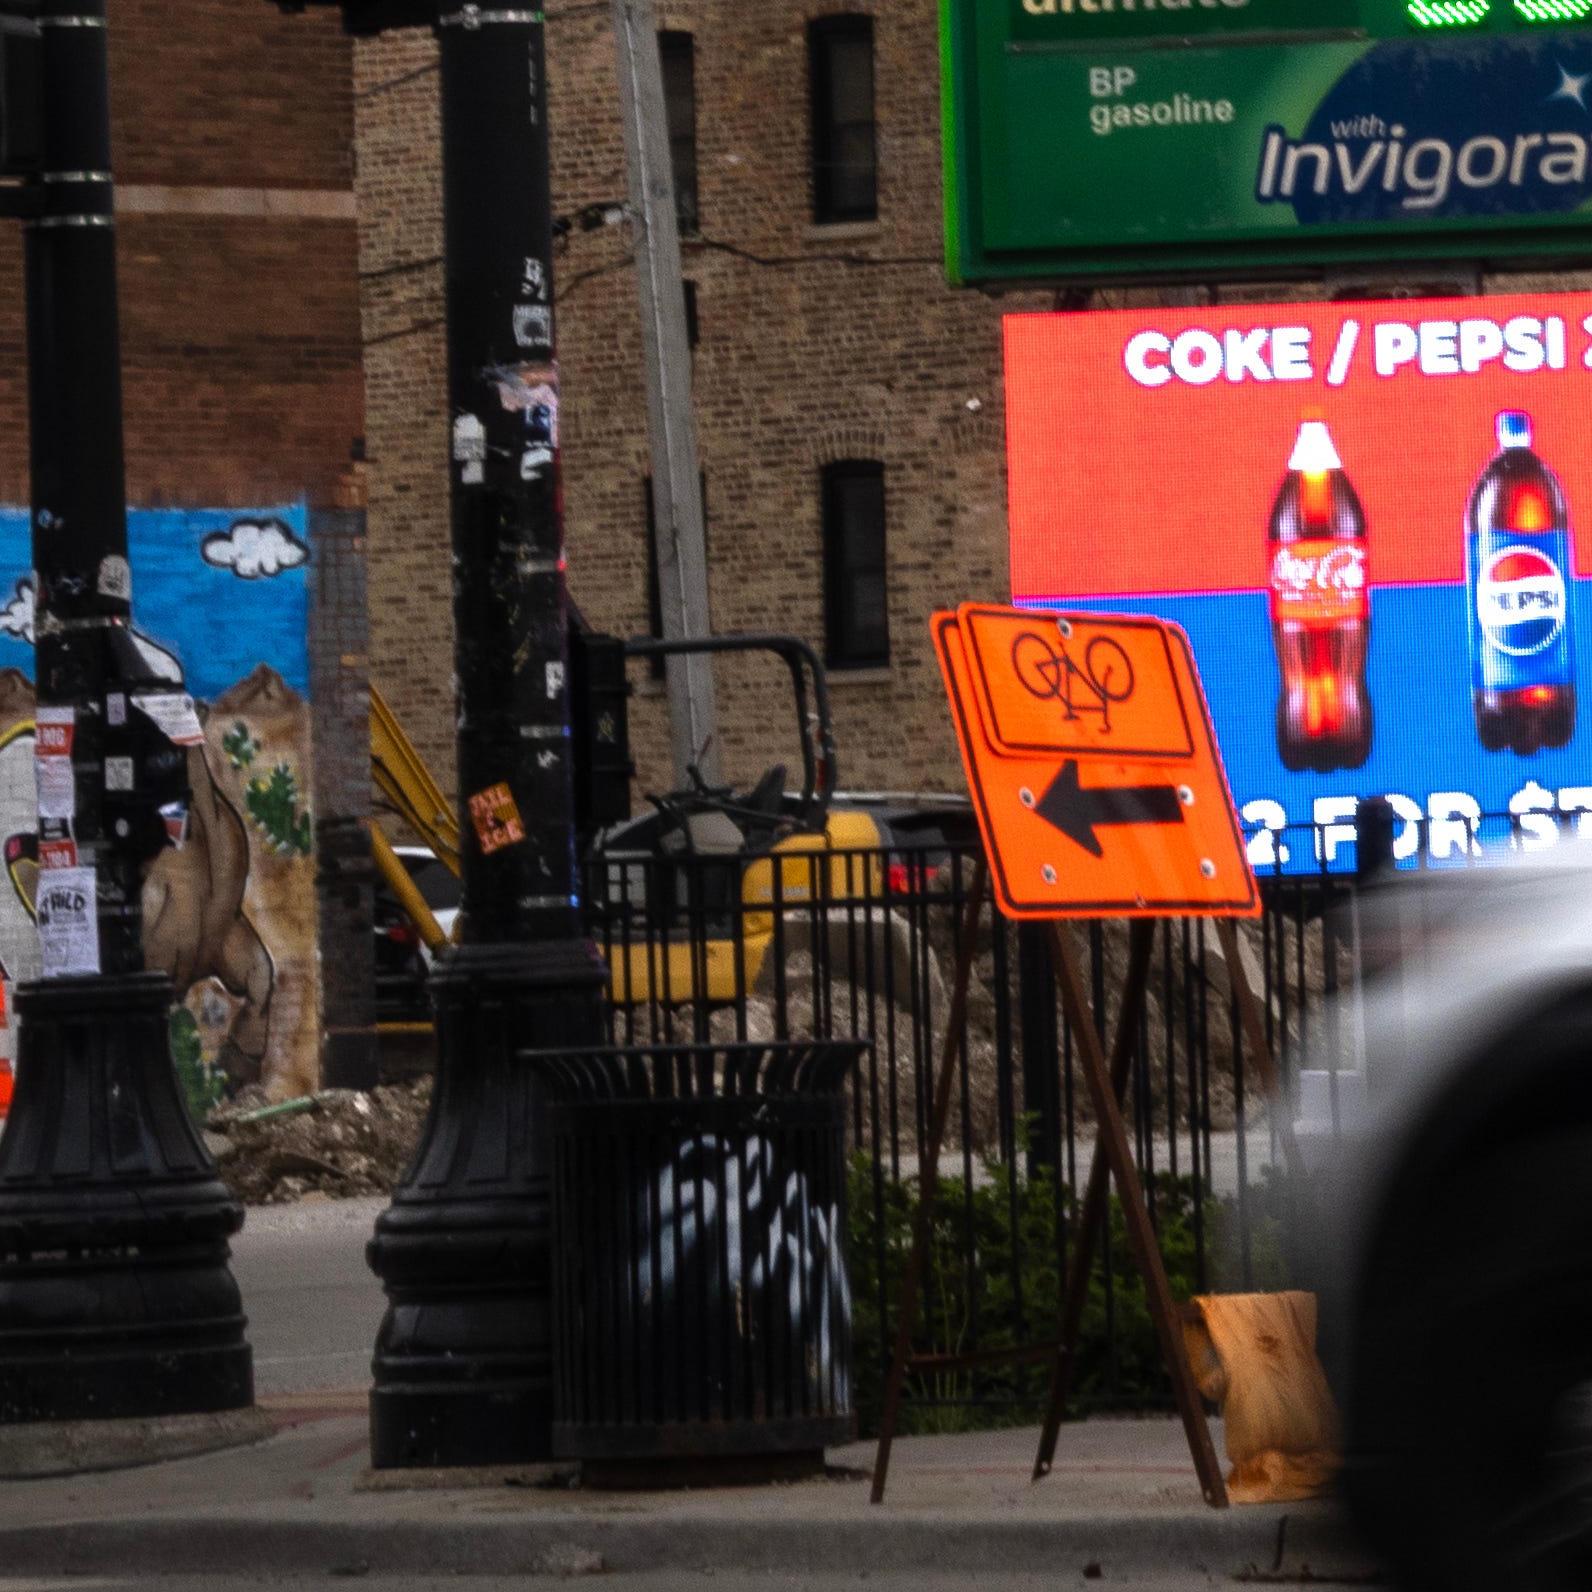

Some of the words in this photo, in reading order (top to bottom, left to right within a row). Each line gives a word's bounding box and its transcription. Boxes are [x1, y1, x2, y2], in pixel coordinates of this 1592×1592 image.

[1089, 66, 1136, 98] BP
[1089, 92, 1234, 135] gasoline
[1330, 113, 1387, 138] with
[1124, 327, 1314, 385] COKE
[1328, 320, 1359, 384] /
[1373, 317, 1566, 376] PEPSI
[1242, 799, 1291, 866] 2
